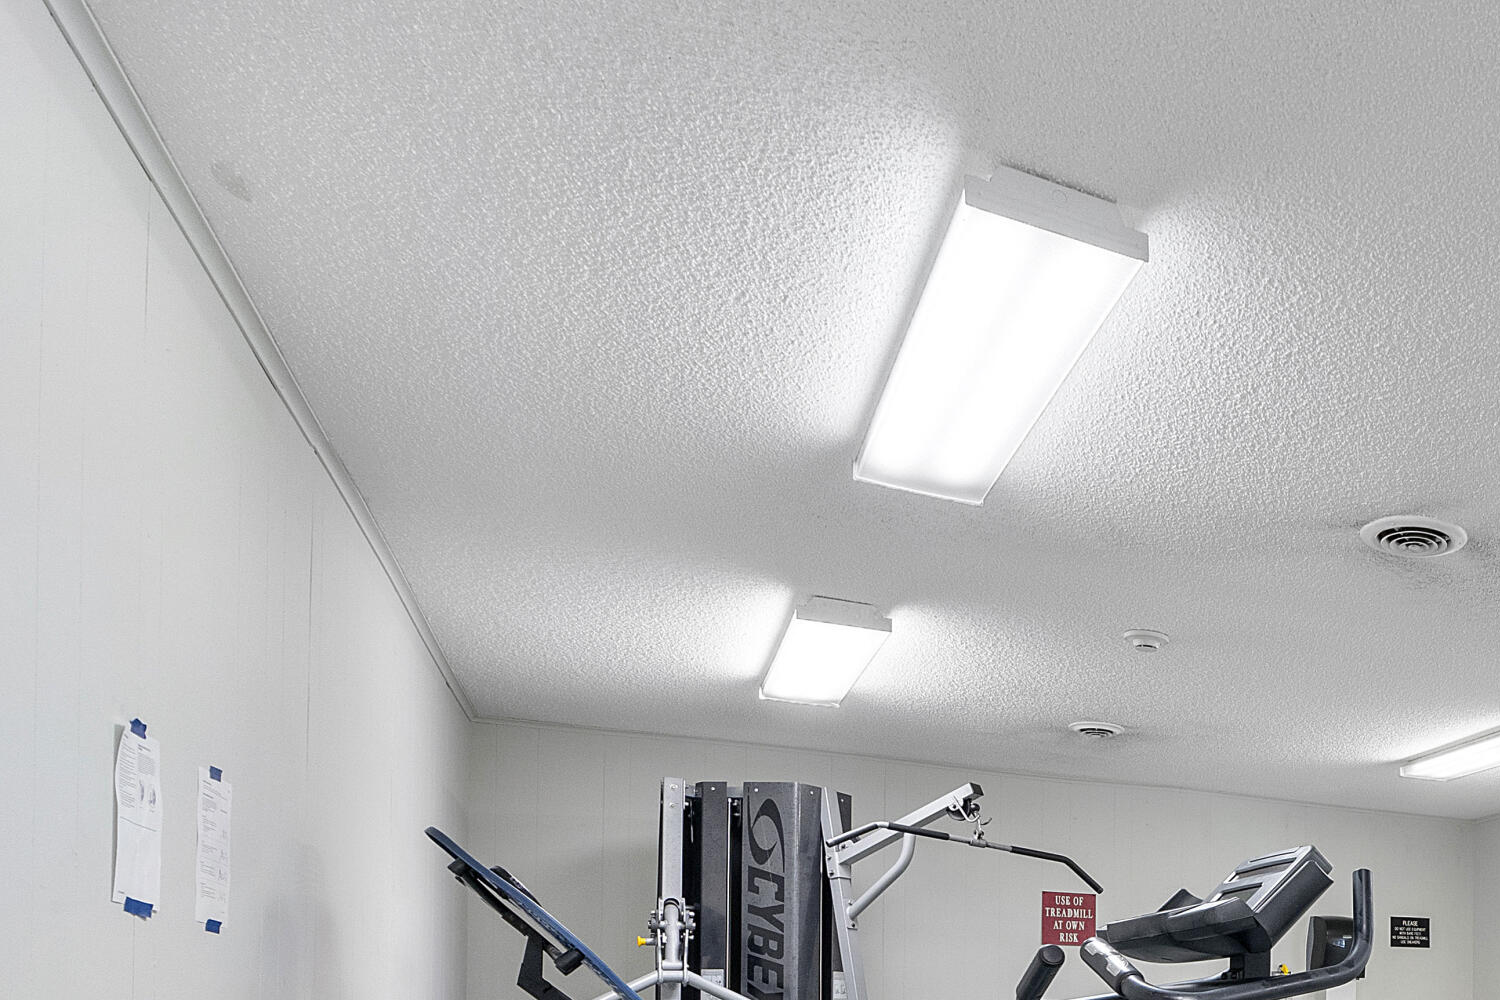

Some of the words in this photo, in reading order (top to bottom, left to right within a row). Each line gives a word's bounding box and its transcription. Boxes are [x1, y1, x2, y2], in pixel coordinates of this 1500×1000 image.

[1055, 895, 1070, 905] USE
[1073, 896, 1084, 906] OF
[1045, 907, 1093, 919] TREADMILL
[1053, 920, 1063, 930] AT
[1065, 920, 1085, 930] OWN
[1059, 932, 1079, 943] RISK
